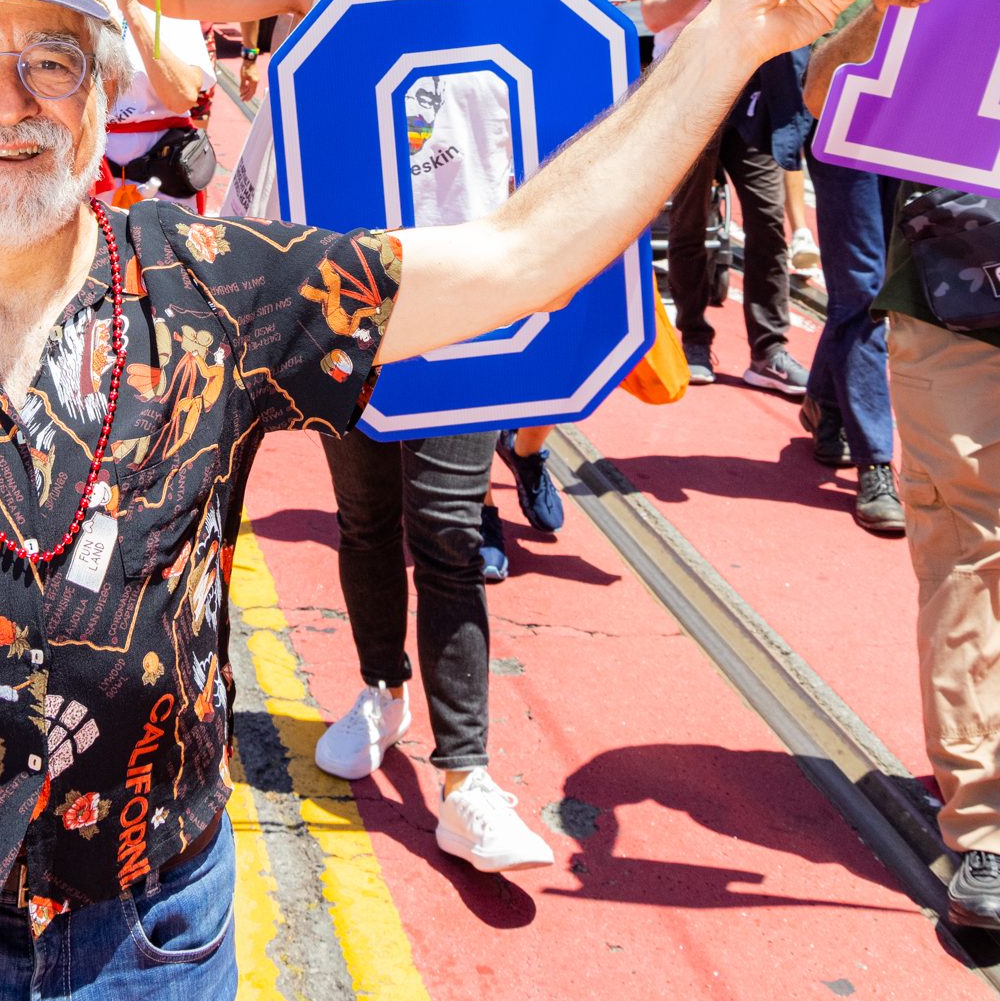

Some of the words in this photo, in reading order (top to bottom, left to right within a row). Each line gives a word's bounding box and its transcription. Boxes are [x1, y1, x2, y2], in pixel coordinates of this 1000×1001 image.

[411, 144, 460, 176] eskin
[78, 539, 94, 564] FUN
[88, 542, 105, 572] LAND
